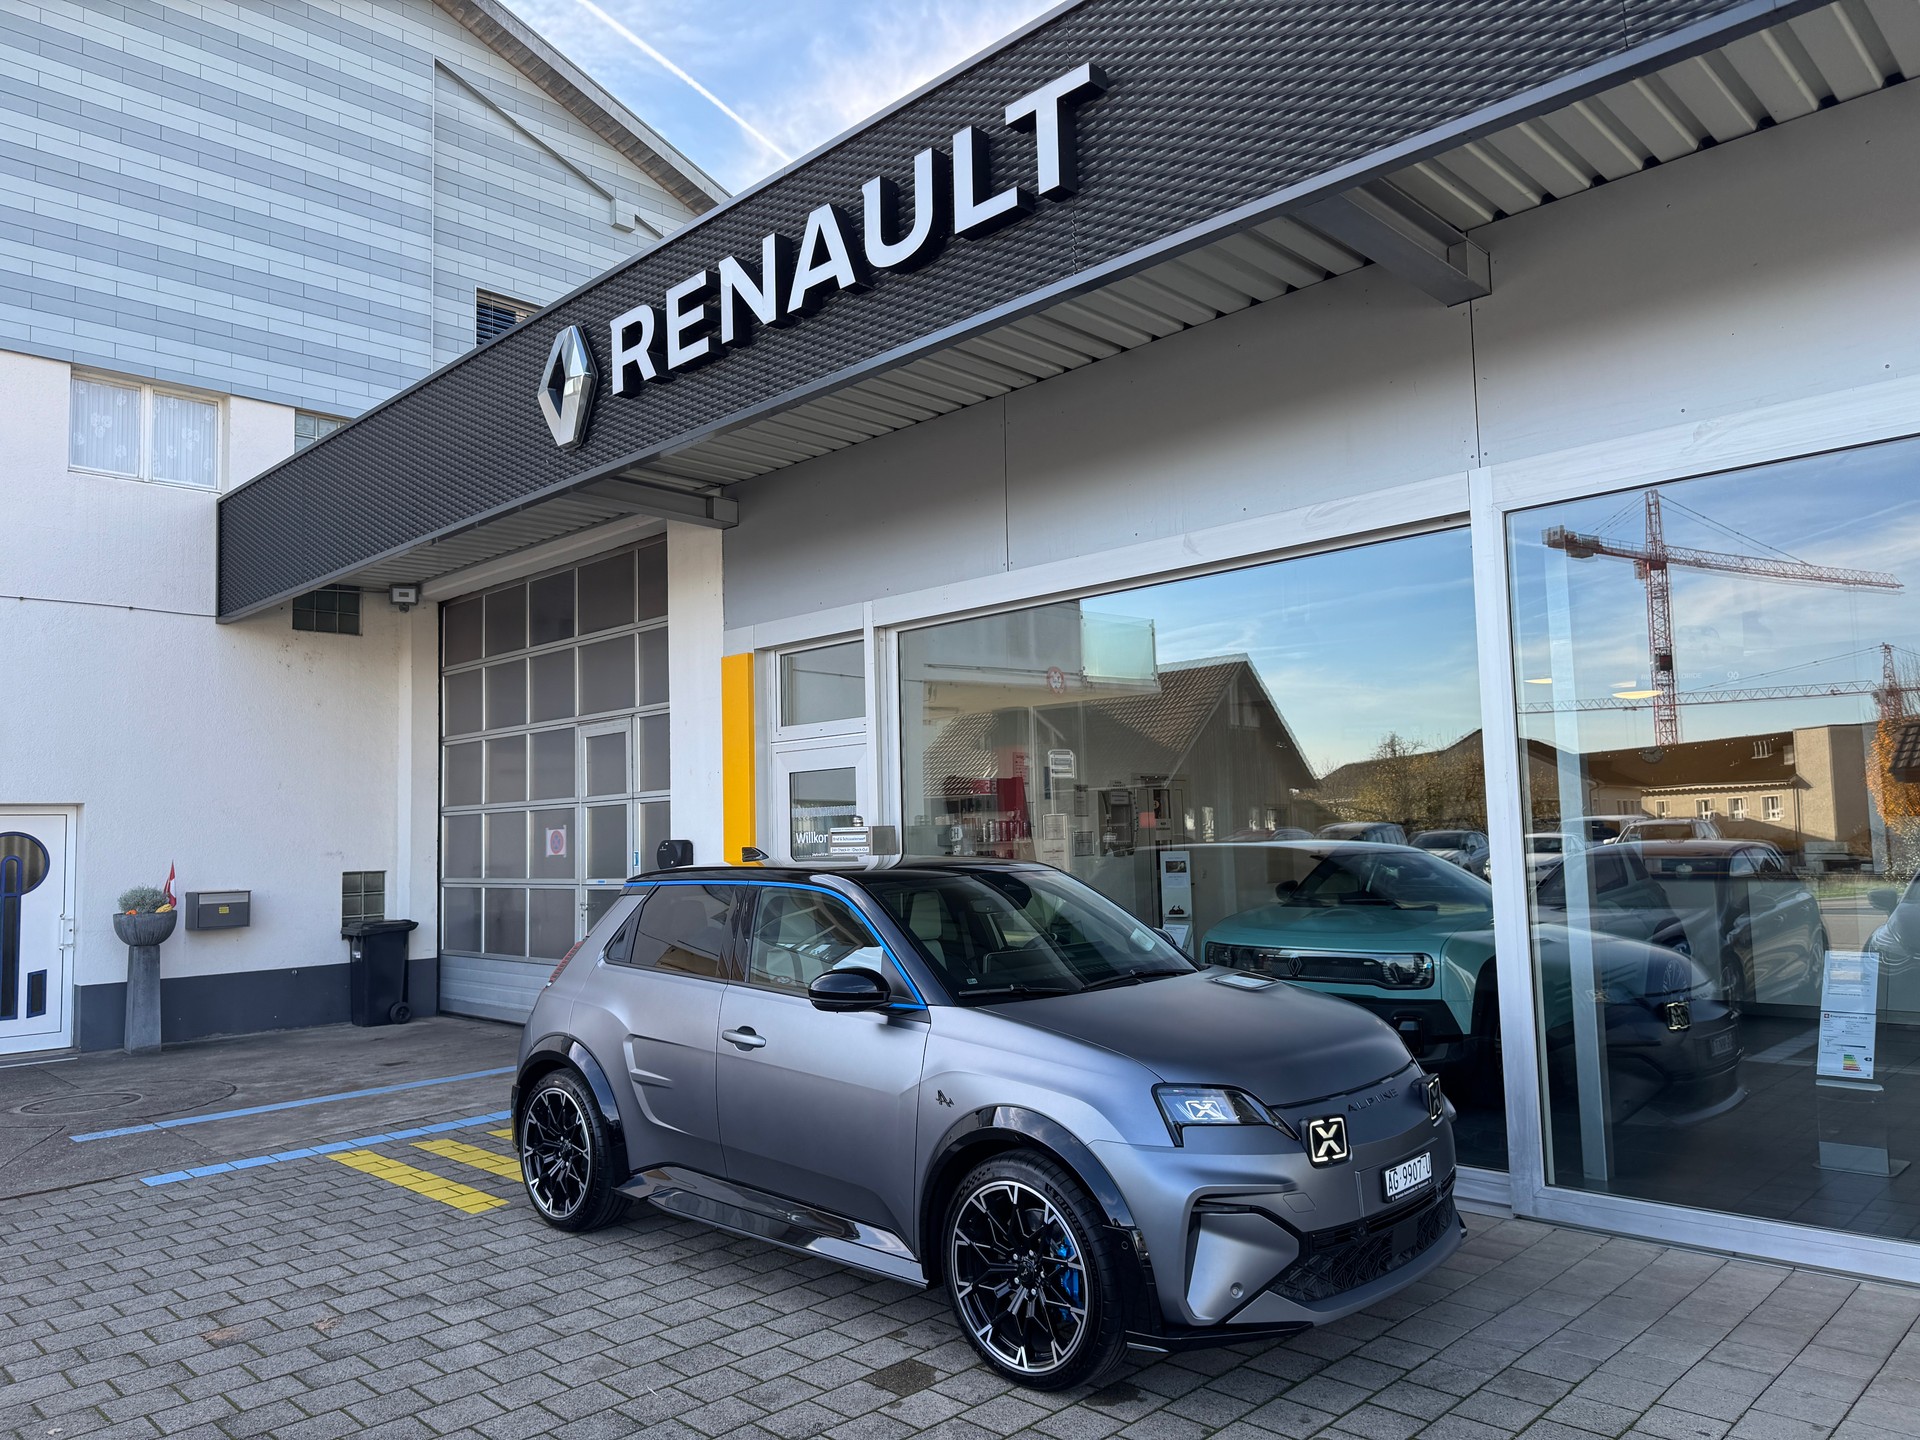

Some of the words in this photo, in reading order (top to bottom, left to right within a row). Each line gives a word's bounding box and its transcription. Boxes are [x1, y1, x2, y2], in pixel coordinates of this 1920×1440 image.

[610, 62, 1093, 397] RENAULT
[1347, 1089, 1399, 1112] ALPINE
[1053, 1194, 1092, 1251] MICHELIN
